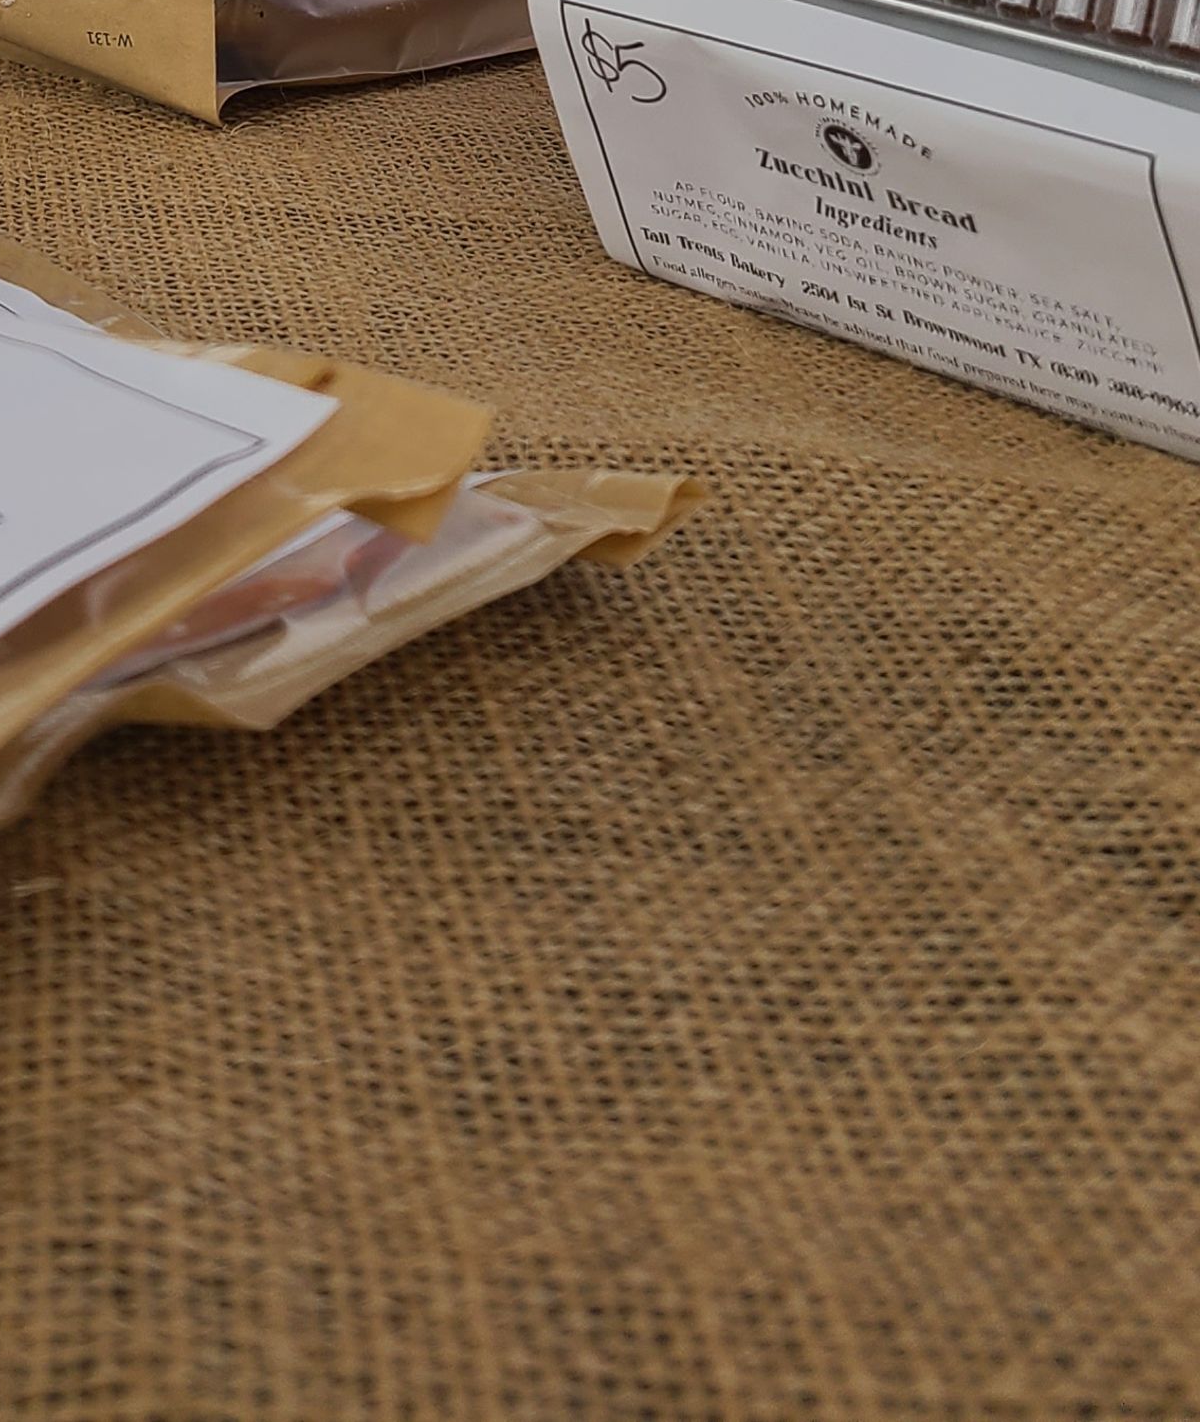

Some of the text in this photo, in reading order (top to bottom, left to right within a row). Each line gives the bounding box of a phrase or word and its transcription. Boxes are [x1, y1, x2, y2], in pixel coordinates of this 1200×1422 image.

[579, 19, 667, 103] $5
[744, 90, 789, 109] 100%
[795, 91, 932, 159] HOMEMADE
[675, 181, 694, 194] AP
[755, 209, 814, 236] BAKING
[874, 244, 937, 273] BAKING
[755, 147, 875, 202] Zucchini
[886, 189, 978, 234] Bread
[815, 195, 938, 250] Ingredients
[640, 226, 671, 247] Tall
[676, 235, 726, 262] Treats
[730, 252, 786, 288] Bakery
[903, 308, 1007, 358] Brownwood
[1015, 347, 1042, 370] TX
[895, 265, 958, 295] BROWN
